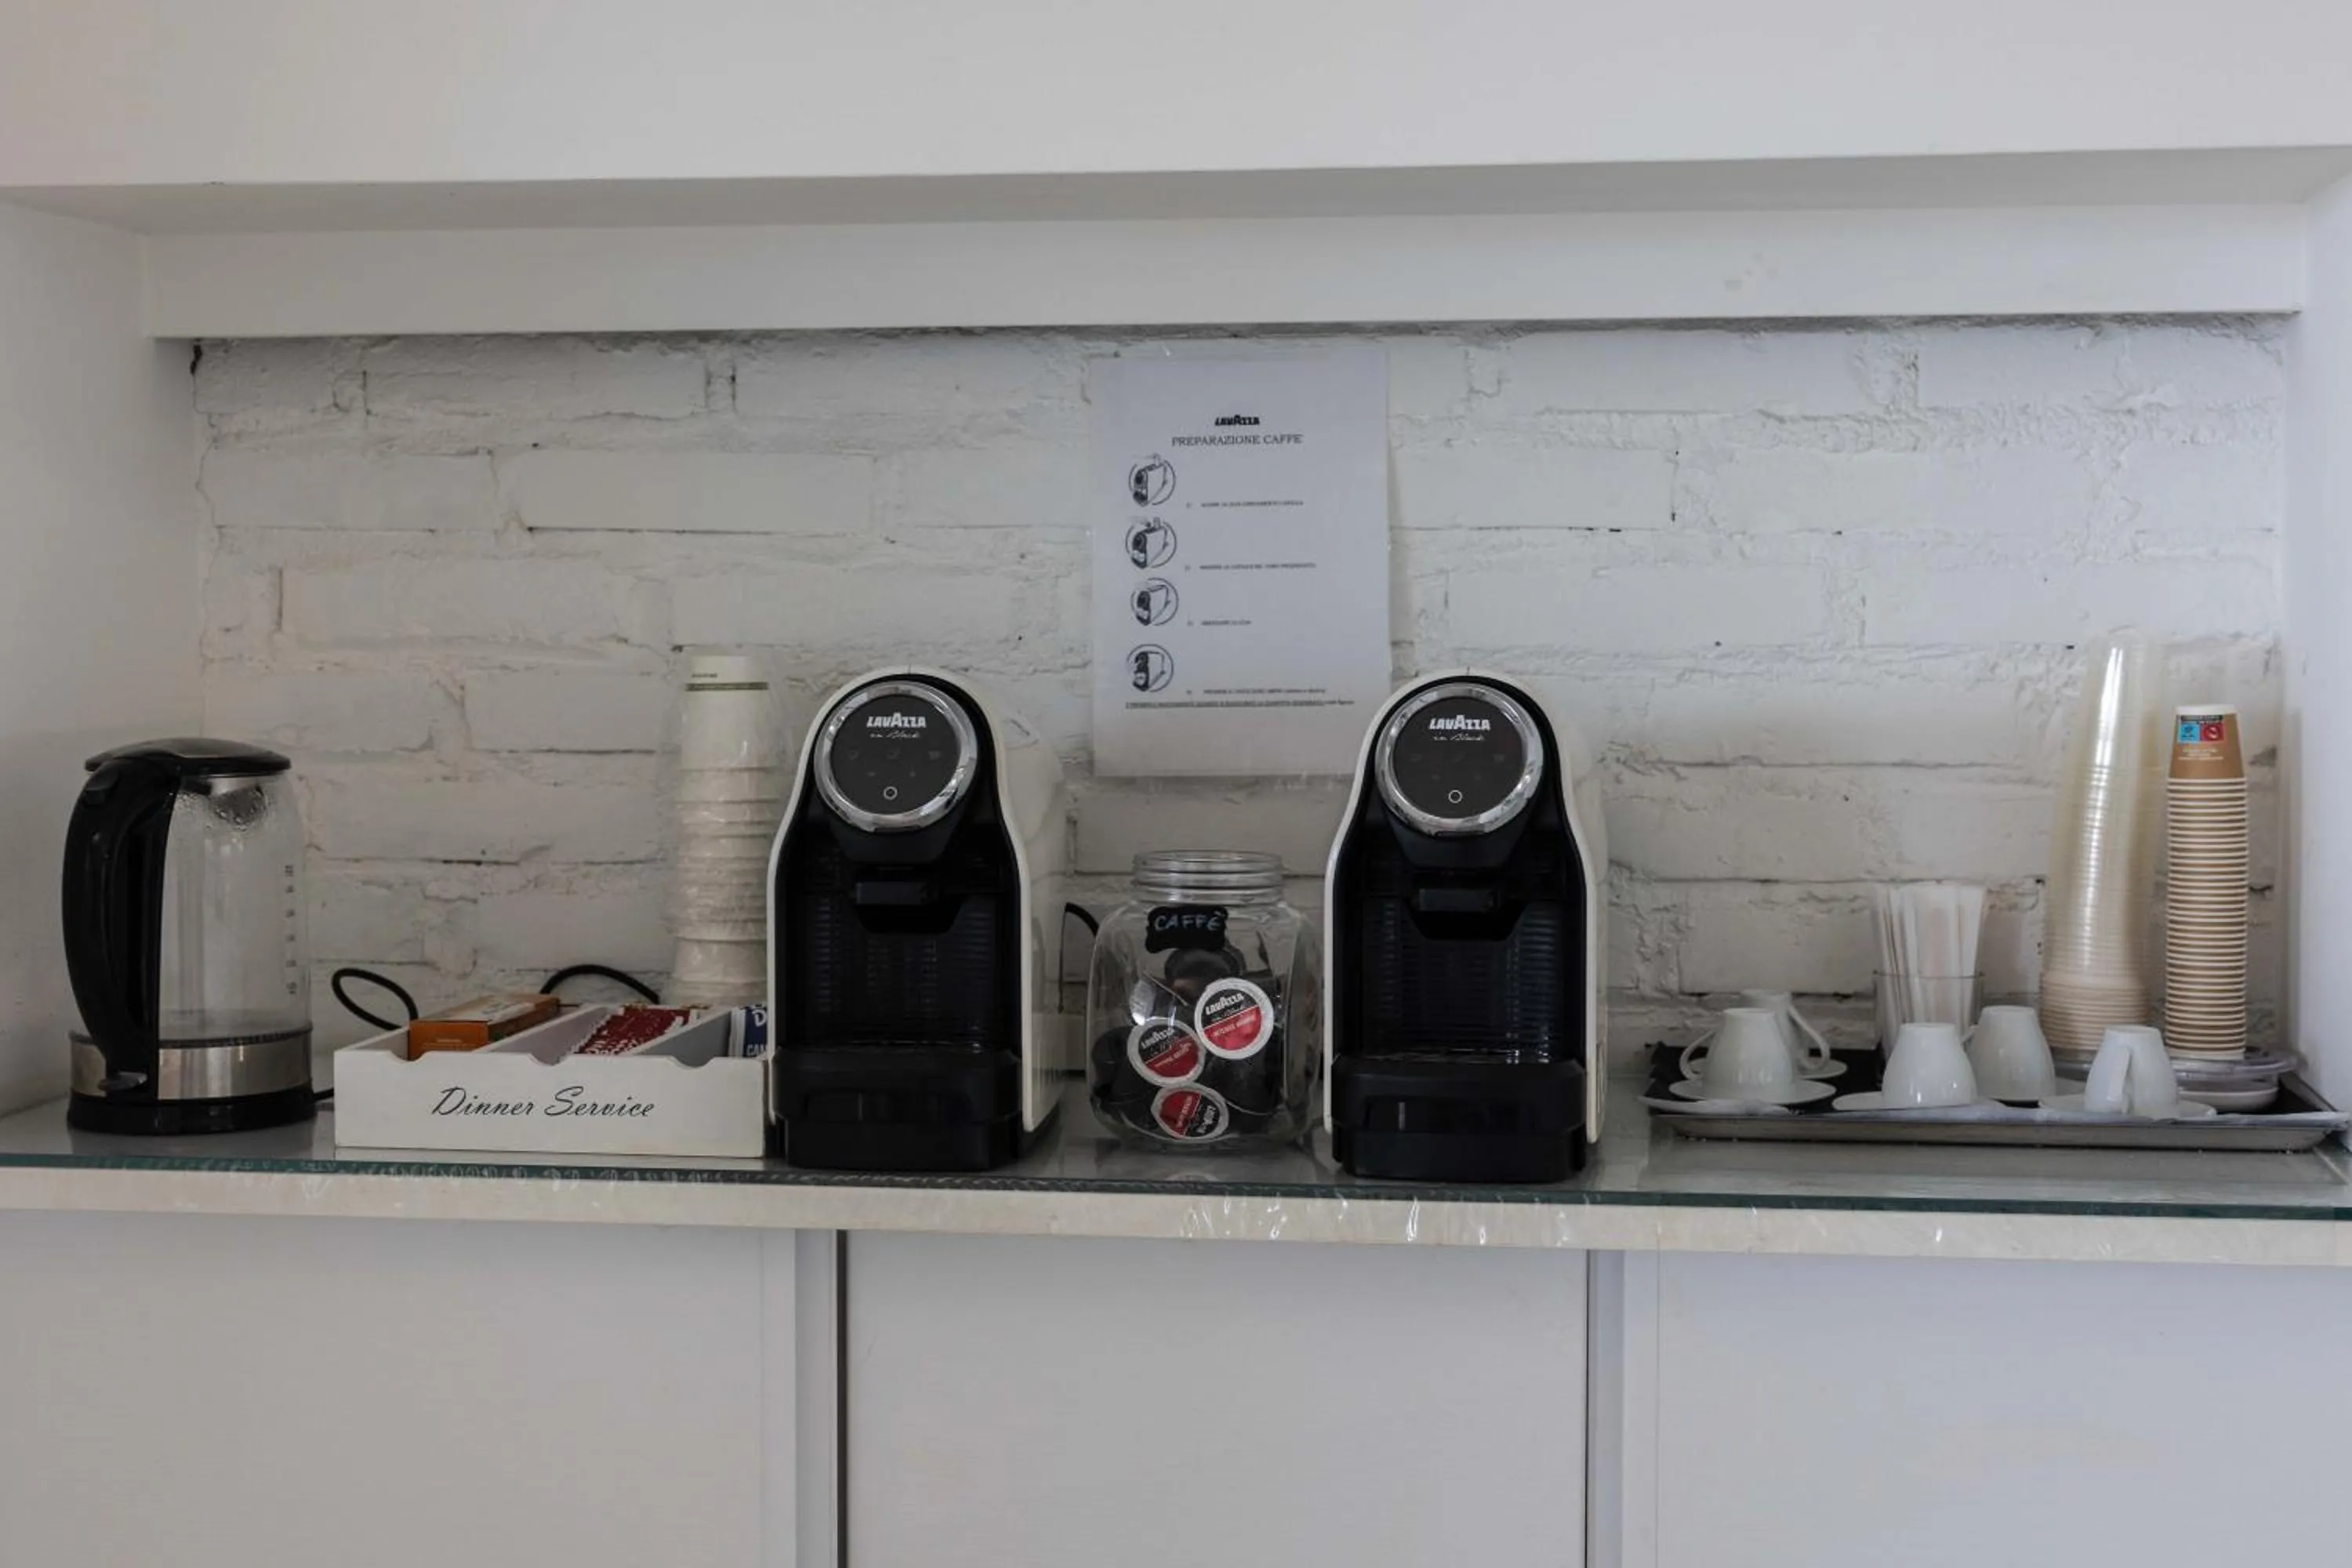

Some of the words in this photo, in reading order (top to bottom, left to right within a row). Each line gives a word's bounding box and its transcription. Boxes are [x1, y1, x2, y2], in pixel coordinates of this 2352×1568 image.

[1214, 414, 1260, 426] LAVAZZA
[1171, 434, 1261, 447] PREPARAZIONE
[866, 712, 927, 728] LAVAZZA
[1428, 714, 1491, 731] LAVAZZA
[1205, 993, 1244, 1015] LAVAZZA
[431, 1087, 534, 1116] Dinner
[544, 1086, 655, 1117] Service
